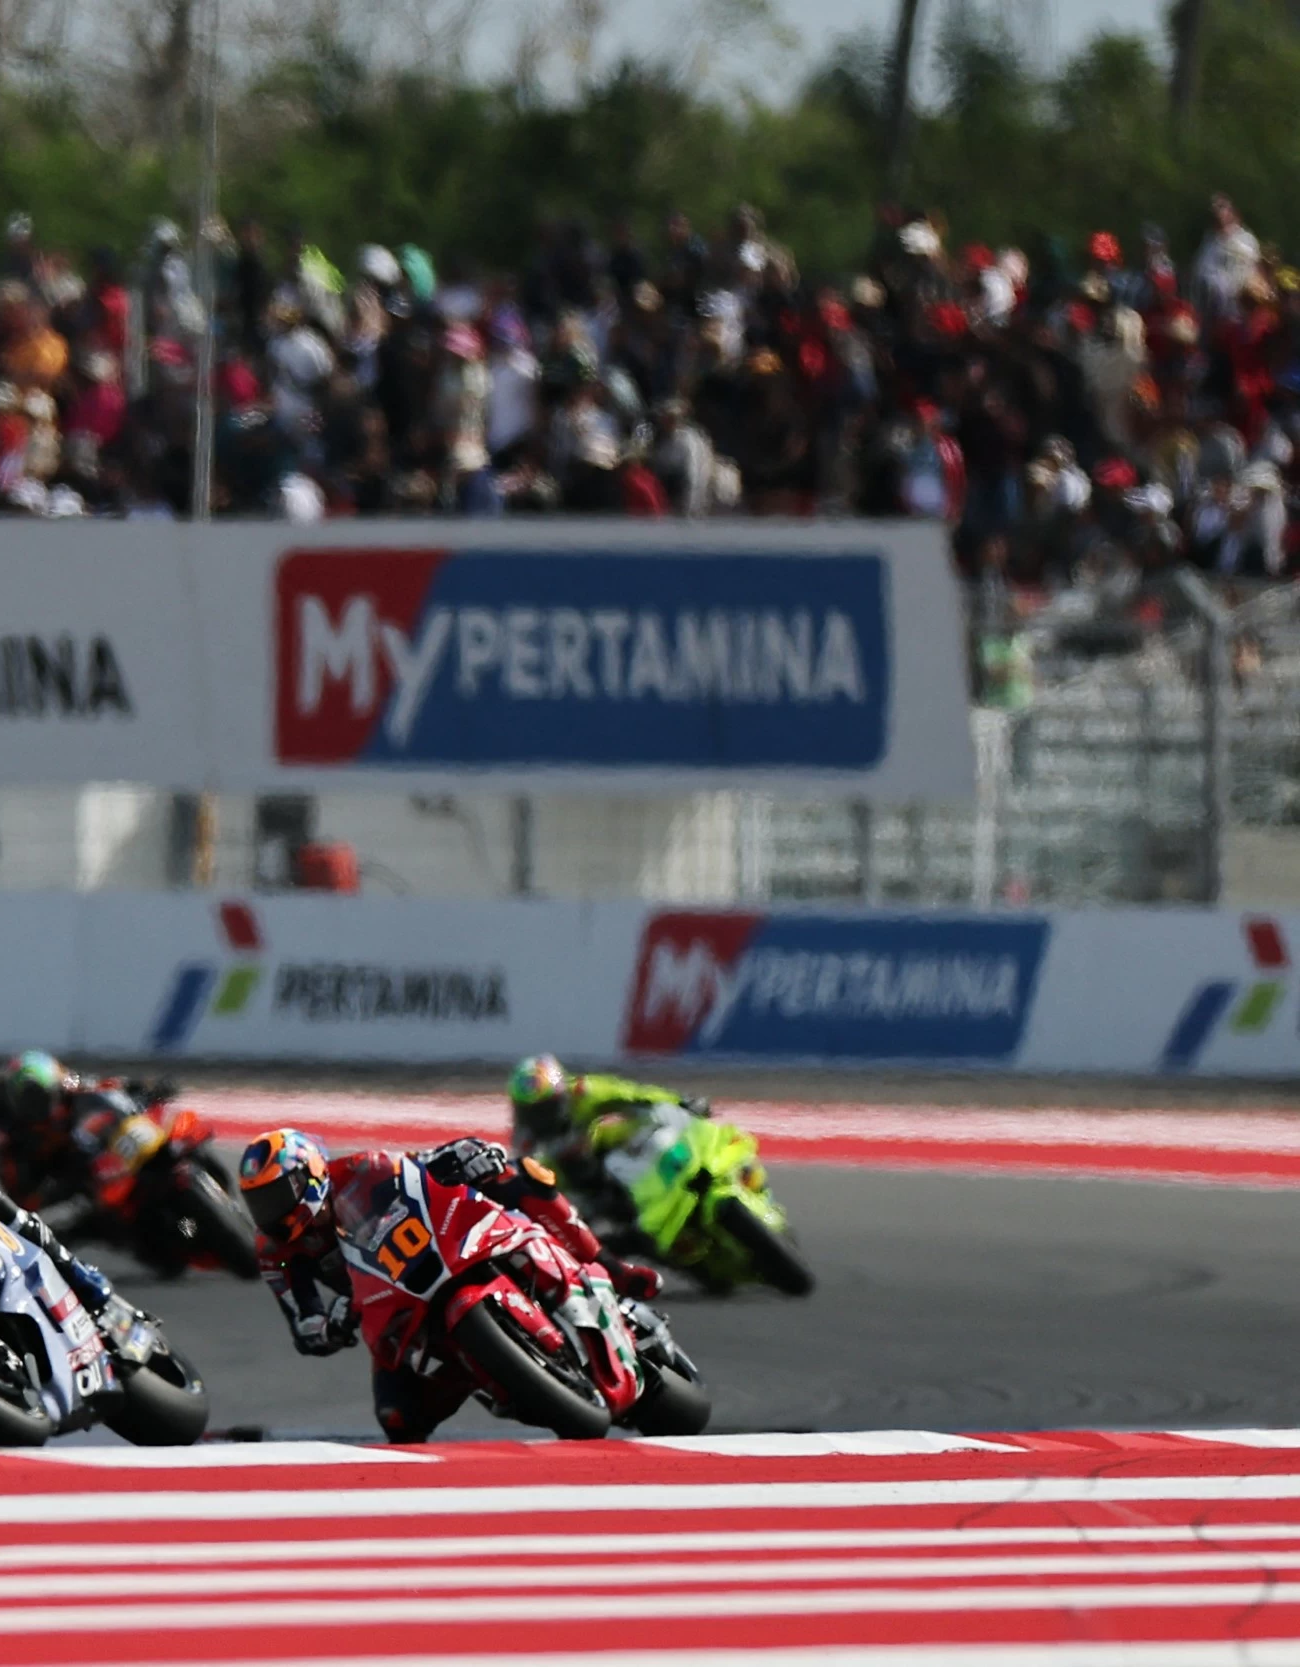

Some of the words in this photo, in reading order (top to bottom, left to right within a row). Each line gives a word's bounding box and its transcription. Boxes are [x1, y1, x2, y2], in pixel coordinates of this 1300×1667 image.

[300, 594, 866, 746] MyPERTAMINA
[273, 962, 507, 1024] PERTAMINA
[377, 1216, 432, 1281] 10
